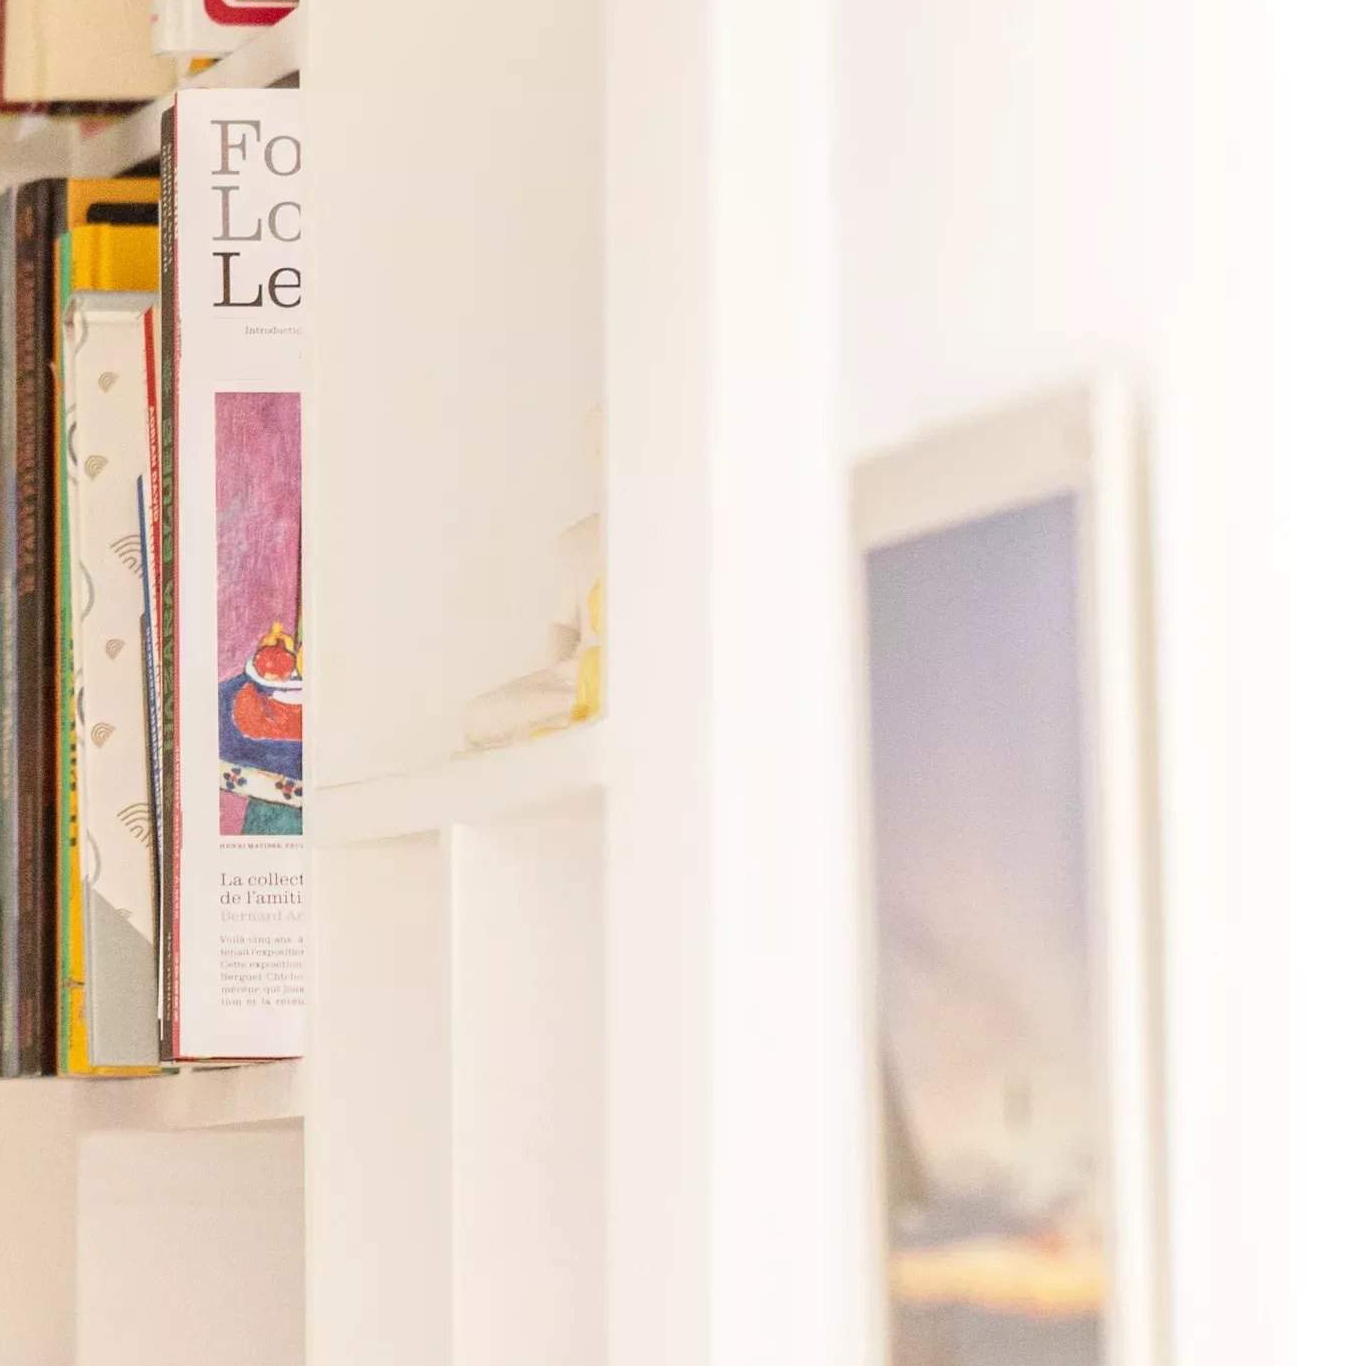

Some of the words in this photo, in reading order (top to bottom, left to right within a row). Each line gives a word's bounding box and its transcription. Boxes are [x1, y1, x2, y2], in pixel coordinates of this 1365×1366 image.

[210, 119, 302, 177] Fo
[212, 251, 302, 309] Le
[220, 890, 241, 904] de
[221, 872, 243, 886] La
[248, 872, 303, 886] collect
